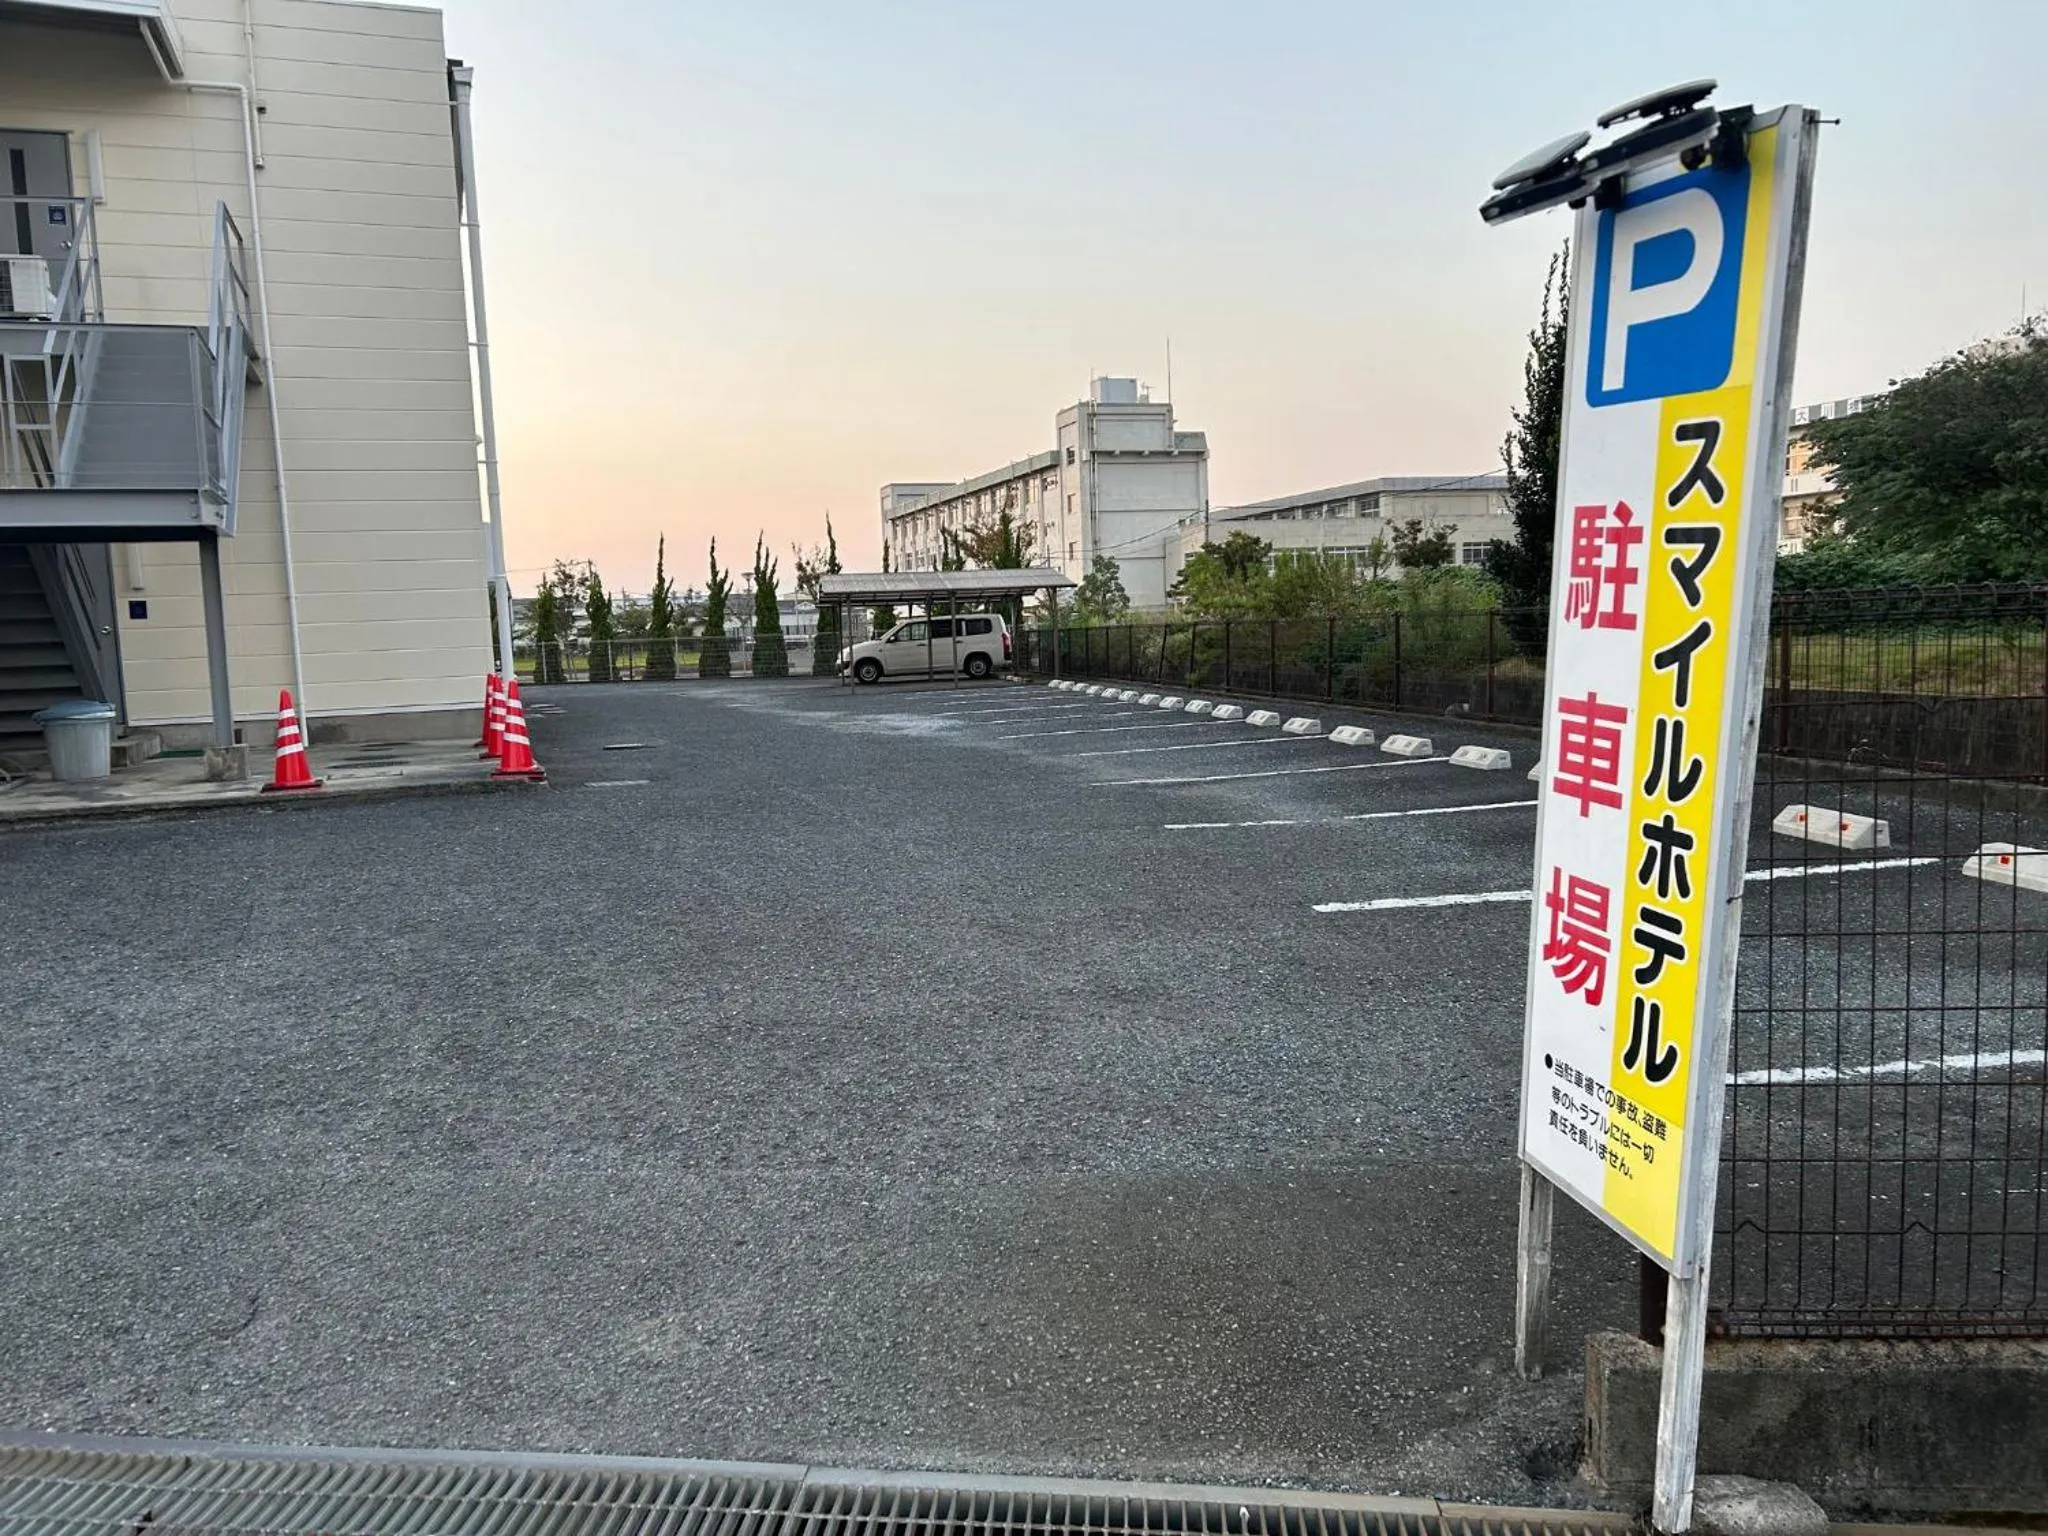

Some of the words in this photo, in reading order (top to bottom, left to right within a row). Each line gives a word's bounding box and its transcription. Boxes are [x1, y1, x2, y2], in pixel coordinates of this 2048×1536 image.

[1602, 187, 1724, 392] P
[1543, 500, 1644, 1007] 駐車場
[1624, 420, 1724, 1083] スマイルホテル
[1548, 1109, 1633, 1180] 責任を負いません。
